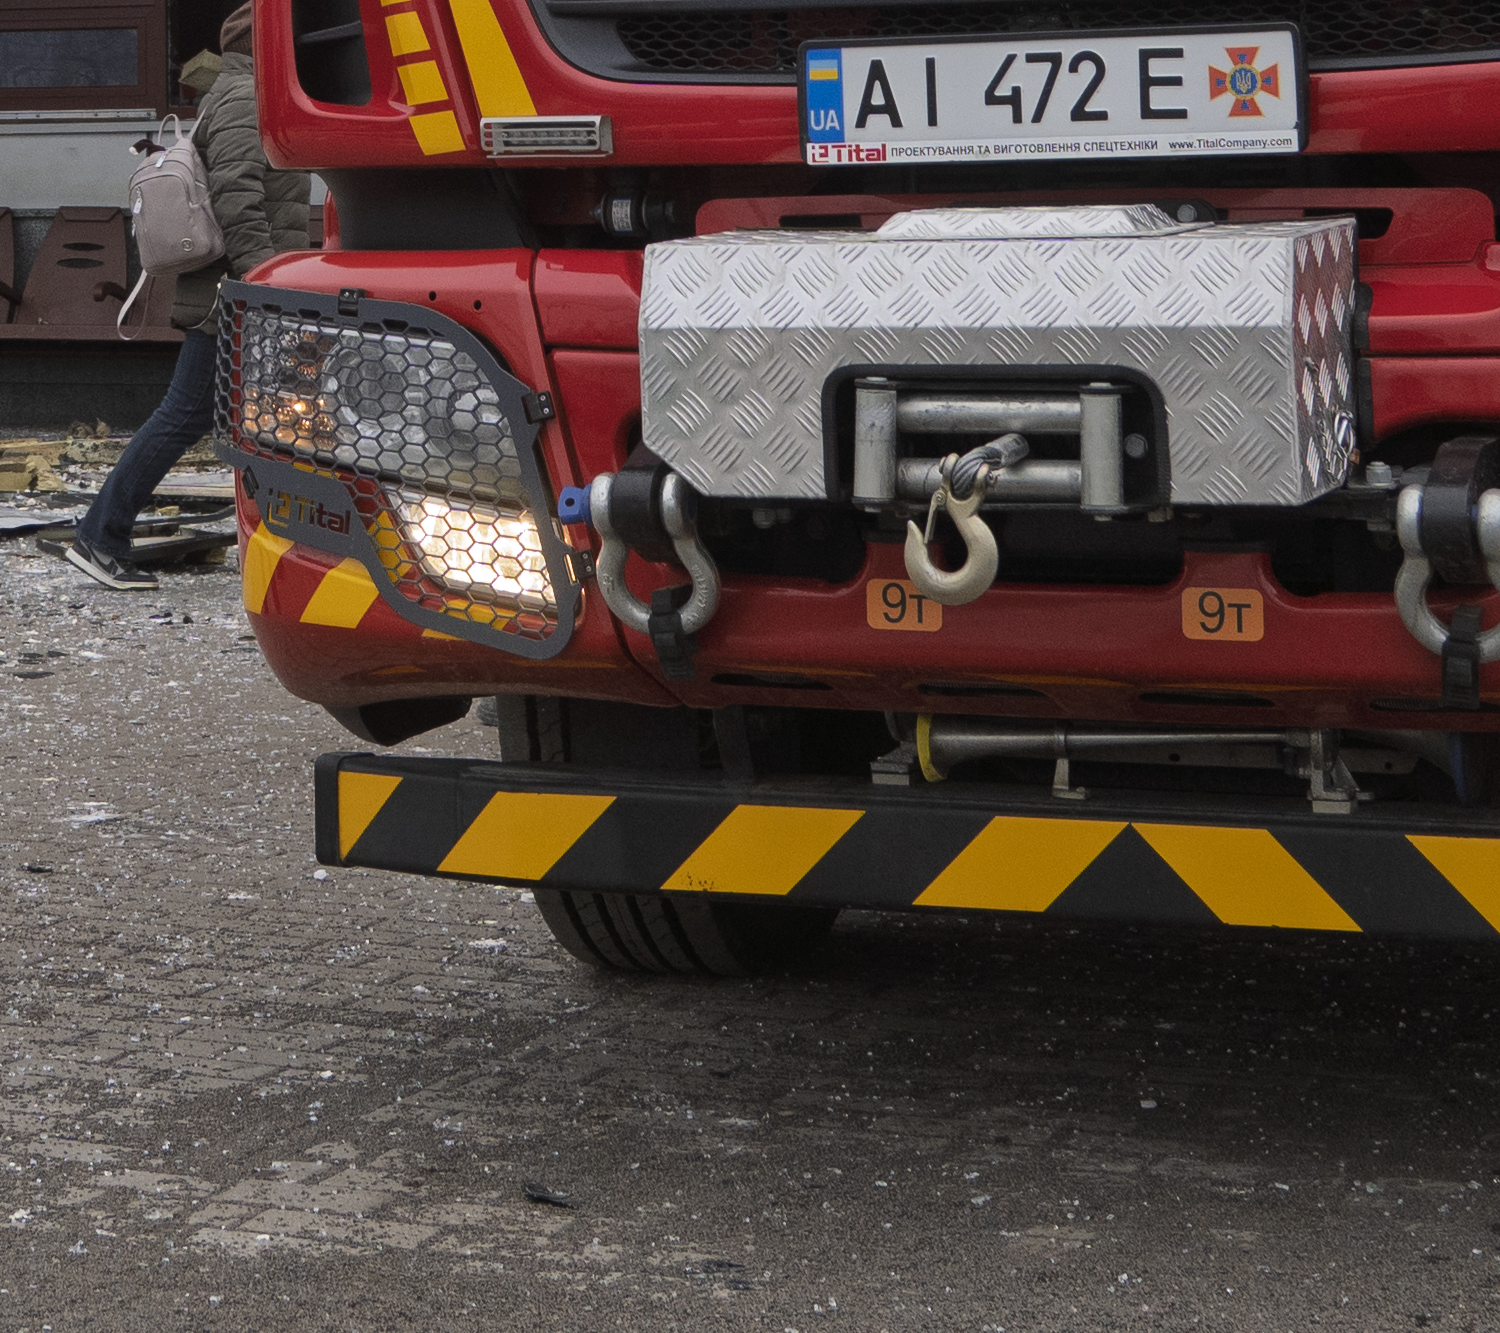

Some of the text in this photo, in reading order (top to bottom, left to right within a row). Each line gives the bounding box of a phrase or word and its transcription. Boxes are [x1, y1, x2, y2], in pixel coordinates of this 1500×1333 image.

[855, 47, 1188, 129] AI 472 E
[810, 109, 841, 131] UA
[831, 143, 887, 163] Tital
[891, 139, 1159, 158] ПРОЕКТУВАННЯ ТА ВИГОТОВЛЕННЯ СПЕЦТЕХНІКИ
[1168, 136, 1293, 151] www.TitalCompany.com
[295, 495, 352, 536] Tital
